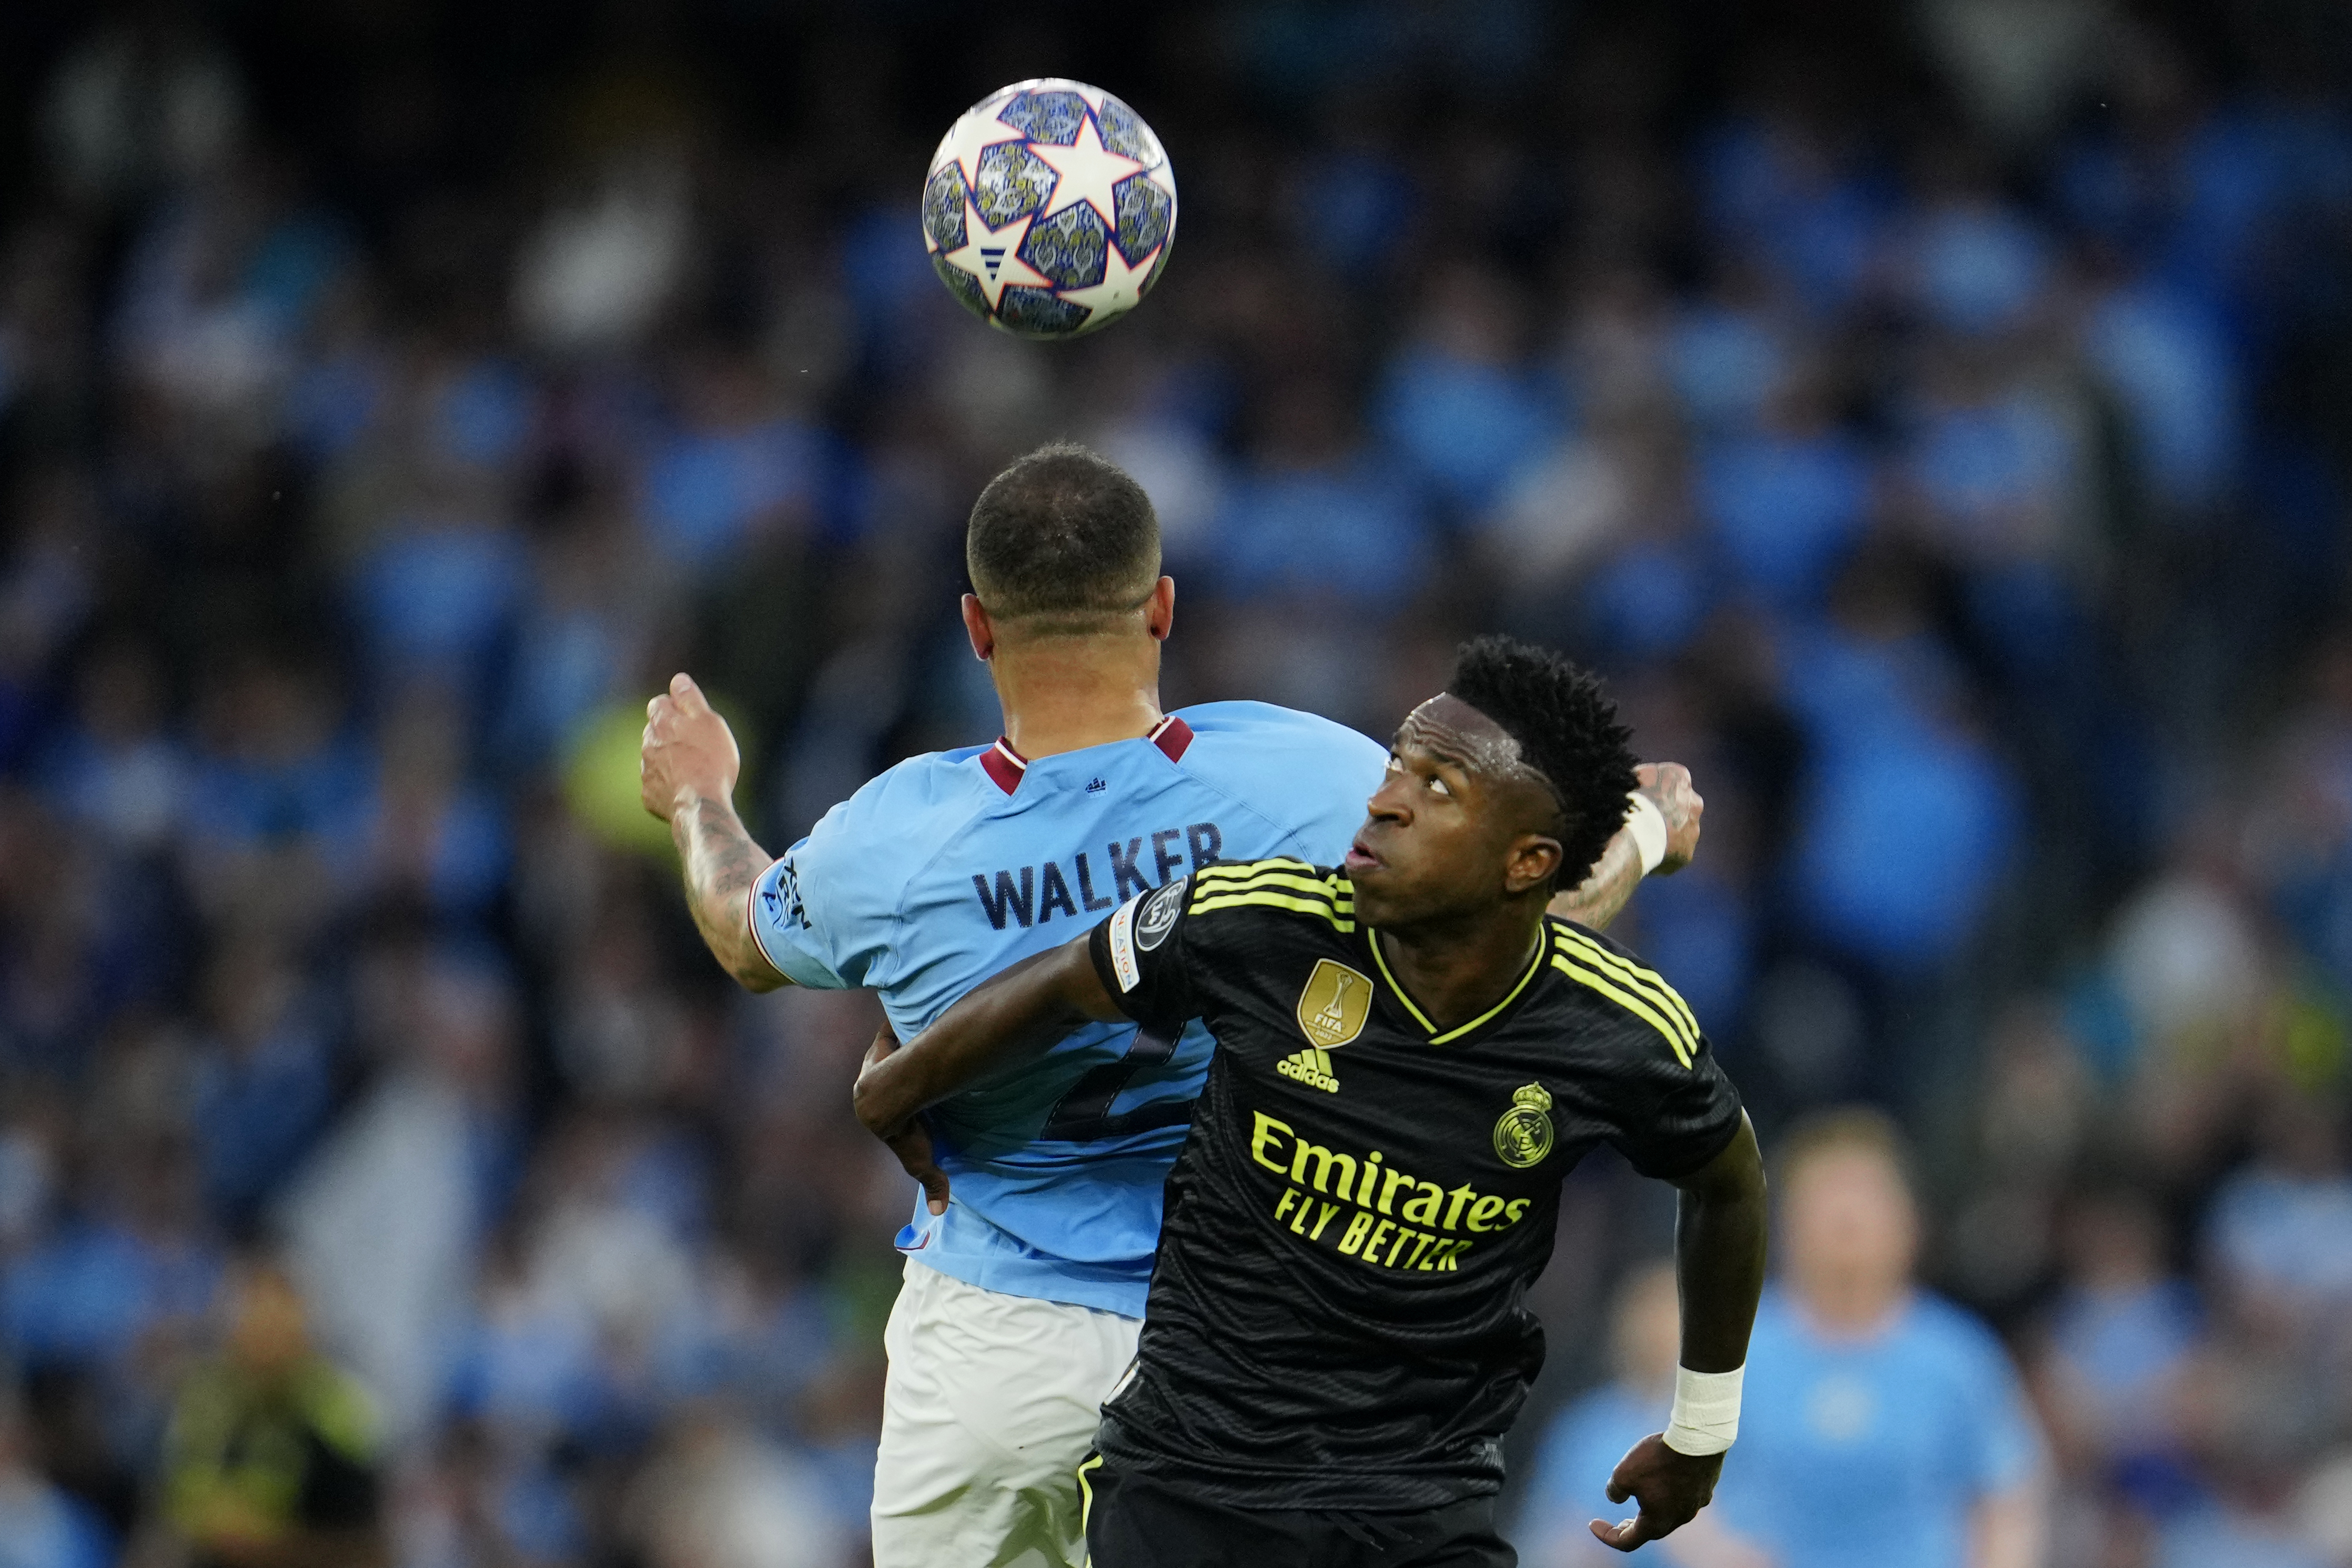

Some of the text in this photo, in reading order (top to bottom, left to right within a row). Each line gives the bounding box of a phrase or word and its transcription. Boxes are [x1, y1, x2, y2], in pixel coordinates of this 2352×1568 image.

[972, 822, 1222, 930] WALKER
[1117, 913, 1133, 986] NDATION
[1315, 1013, 1342, 1033] FIFA
[1277, 1059, 1340, 1094] adidas
[1251, 1110, 1531, 1232] Emirates
[1275, 1187, 1473, 1271] FLY BETTER
